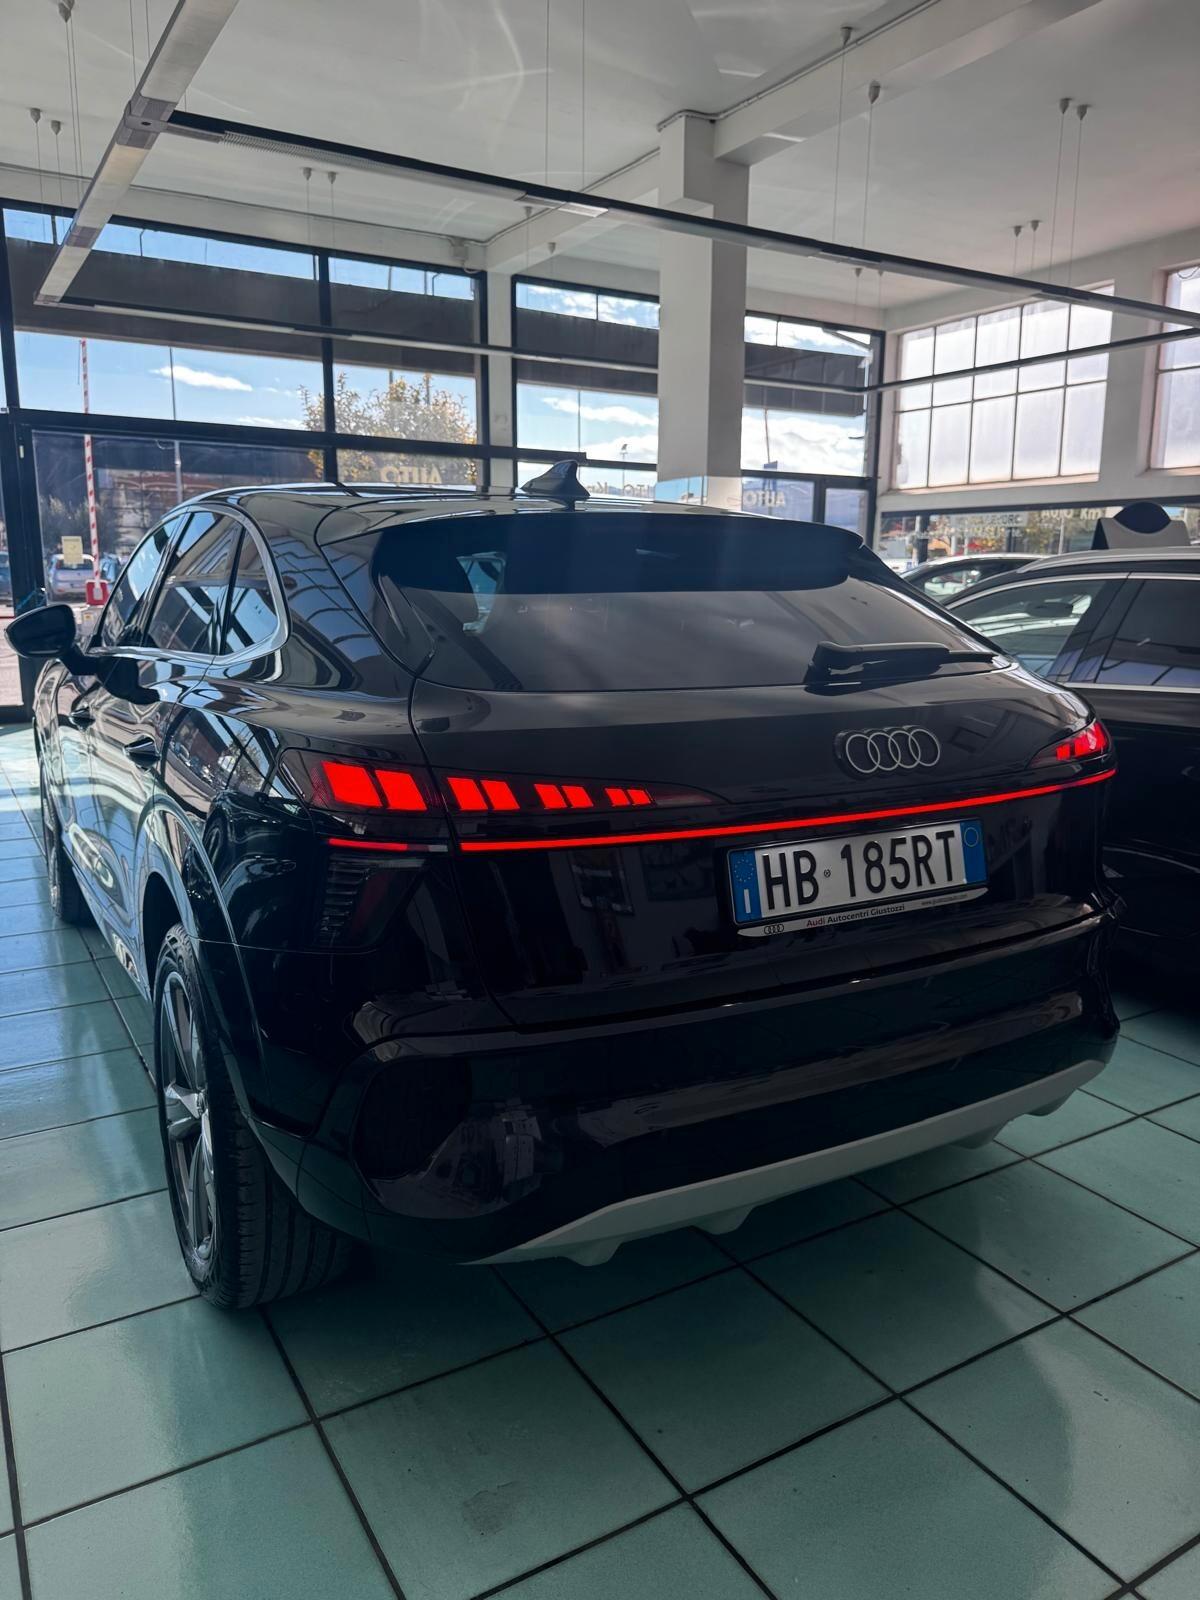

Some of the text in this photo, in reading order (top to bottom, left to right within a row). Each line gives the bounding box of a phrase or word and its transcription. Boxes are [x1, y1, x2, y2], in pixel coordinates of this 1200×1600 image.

[762, 830, 955, 910] HB 185RT
[806, 903, 905, 927] Audi Autocentri Giustozzi
